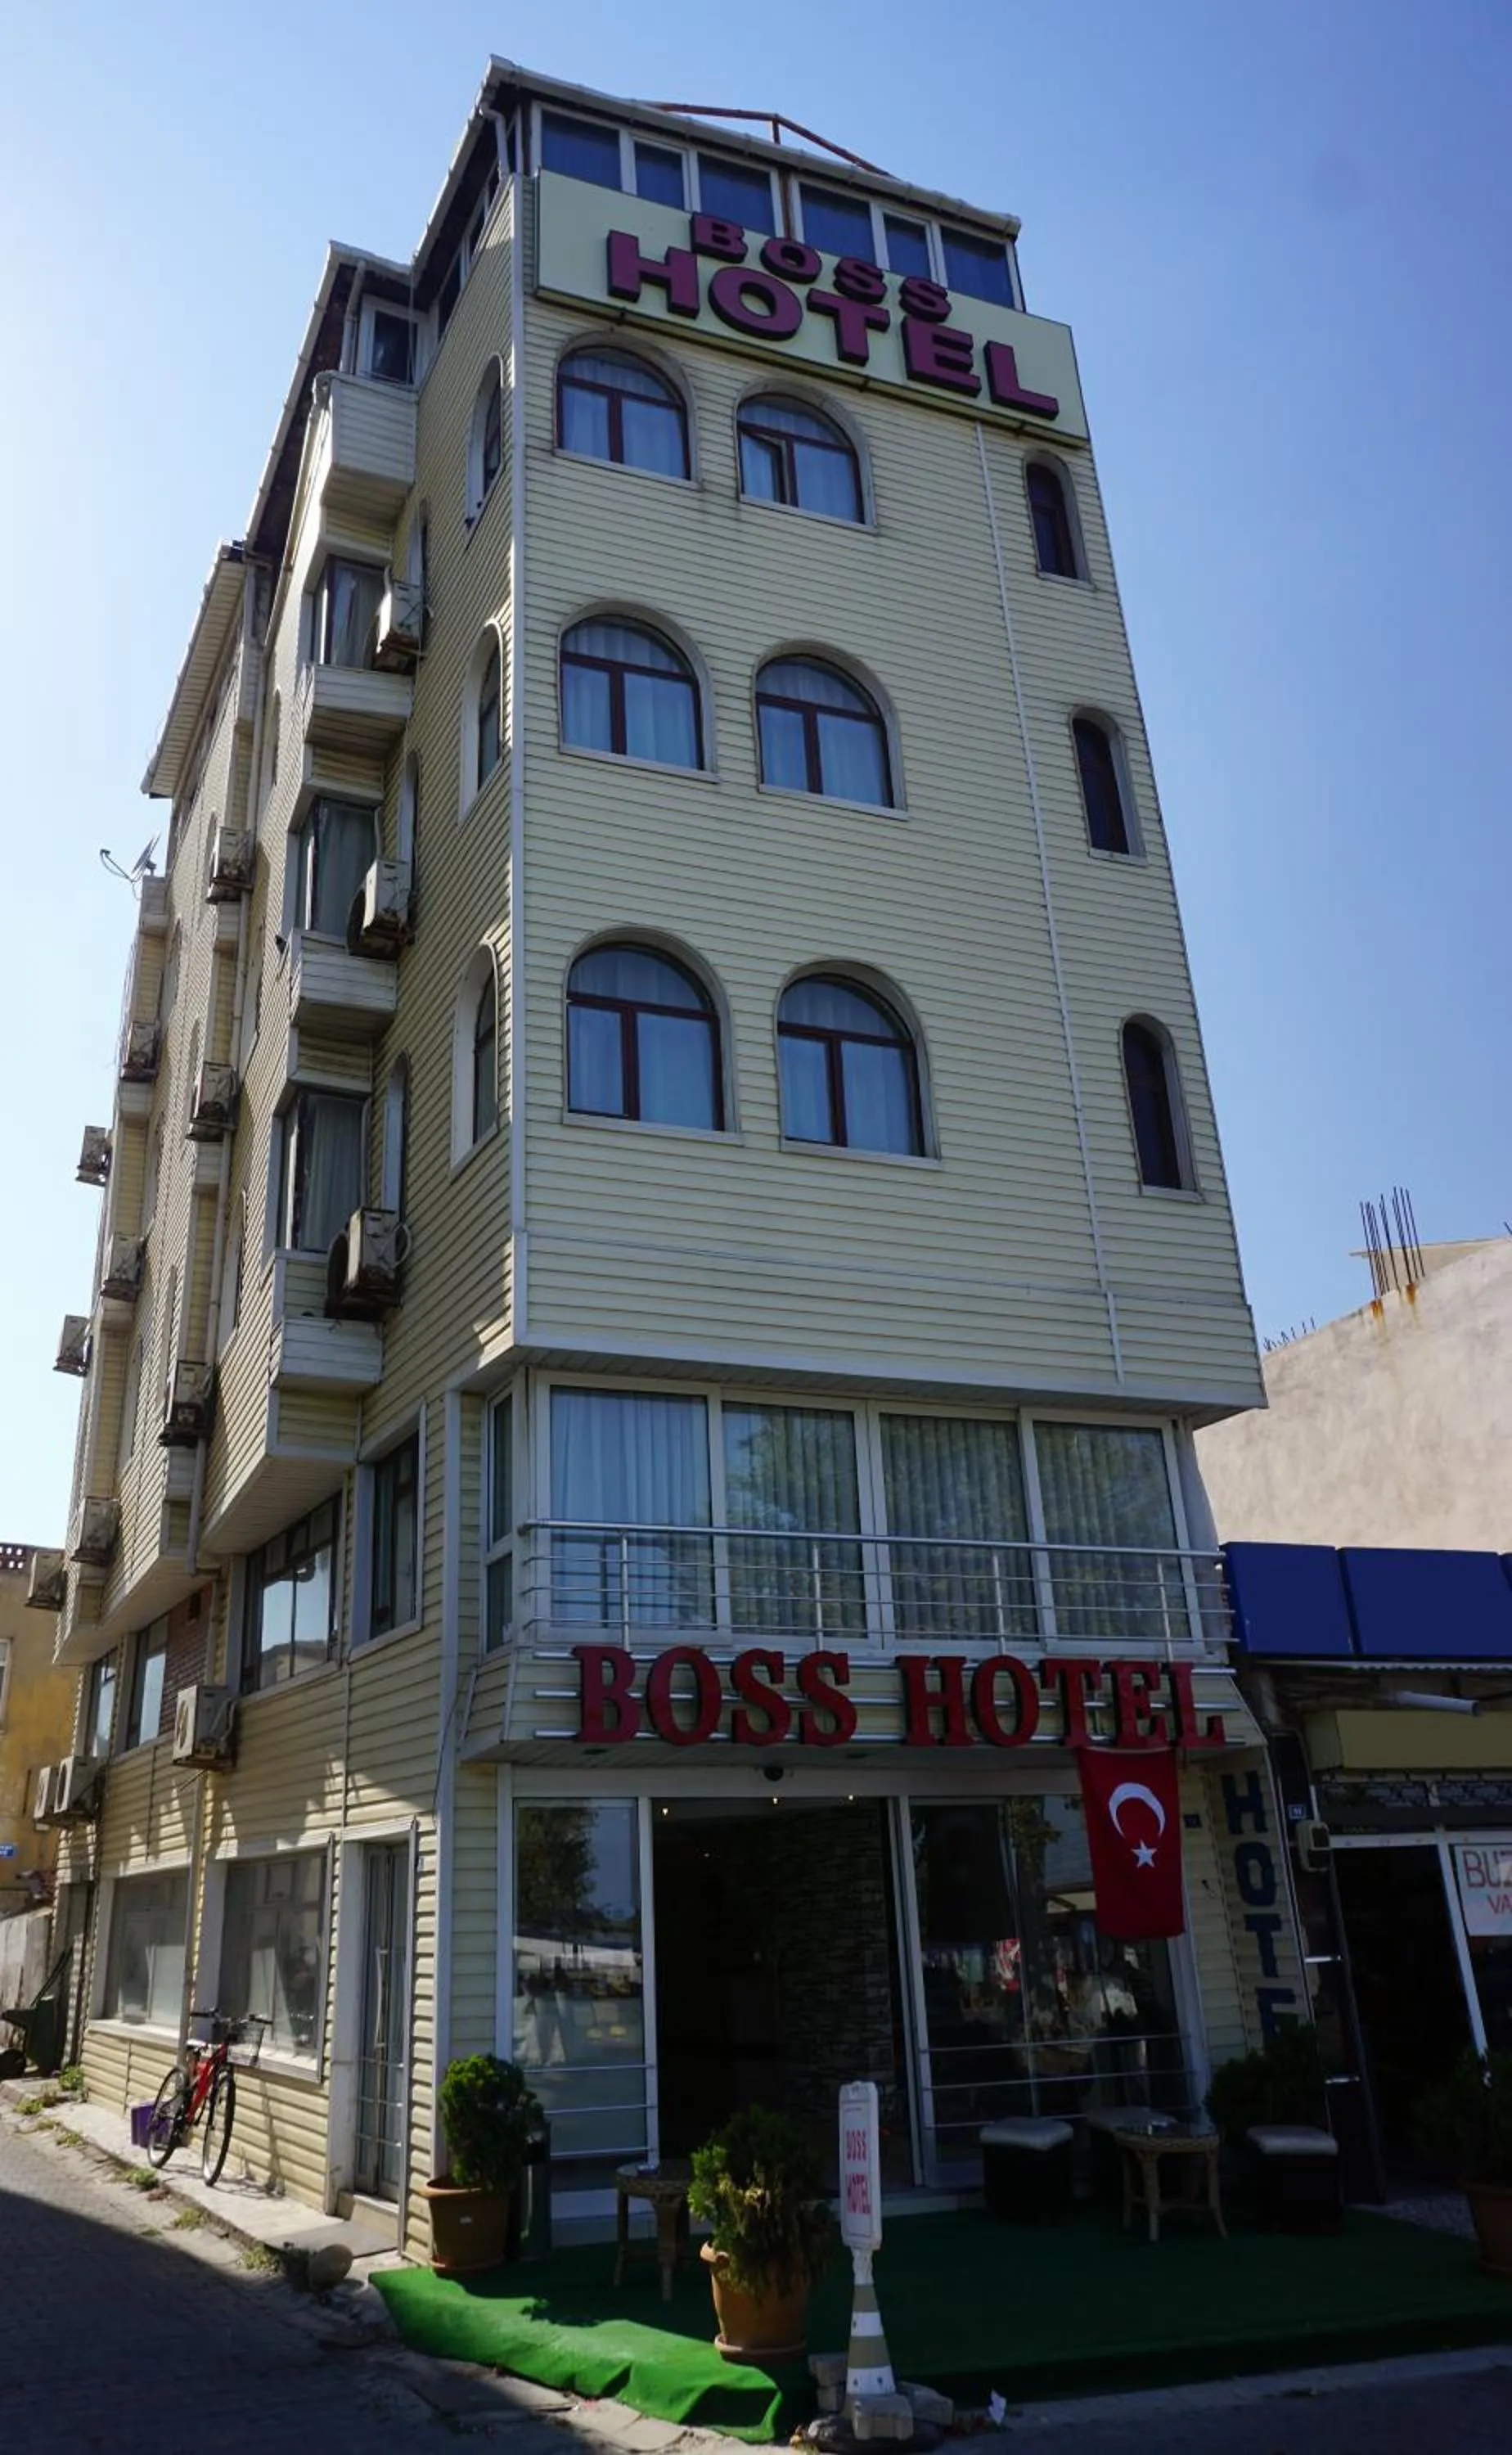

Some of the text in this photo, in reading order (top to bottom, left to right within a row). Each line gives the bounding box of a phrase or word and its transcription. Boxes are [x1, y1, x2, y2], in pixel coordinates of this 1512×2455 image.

[691, 211, 952, 322] BOSS
[605, 229, 1060, 421] HOTEL
[571, 1645, 1226, 1749] BOSS HOTEL
